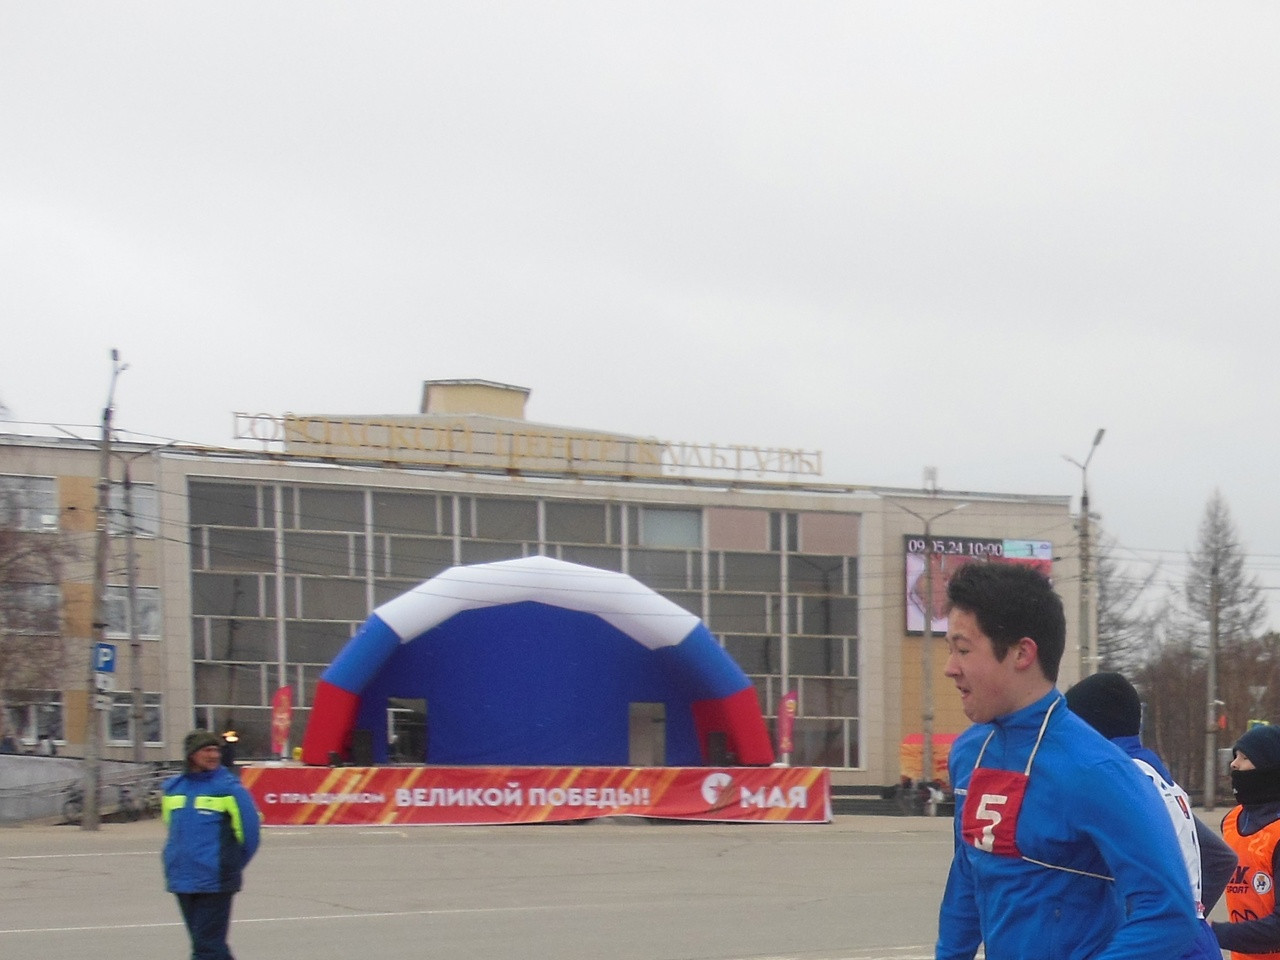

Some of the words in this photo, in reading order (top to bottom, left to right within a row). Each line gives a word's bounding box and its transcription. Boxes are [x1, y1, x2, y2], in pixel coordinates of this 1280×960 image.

[264, 793, 278, 804] С
[395, 782, 521, 807] ВЕЛИКОЙ
[529, 787, 649, 808] ПОБЕДЫ!
[740, 786, 807, 808] МАЯ
[975, 793, 1008, 853] 5
